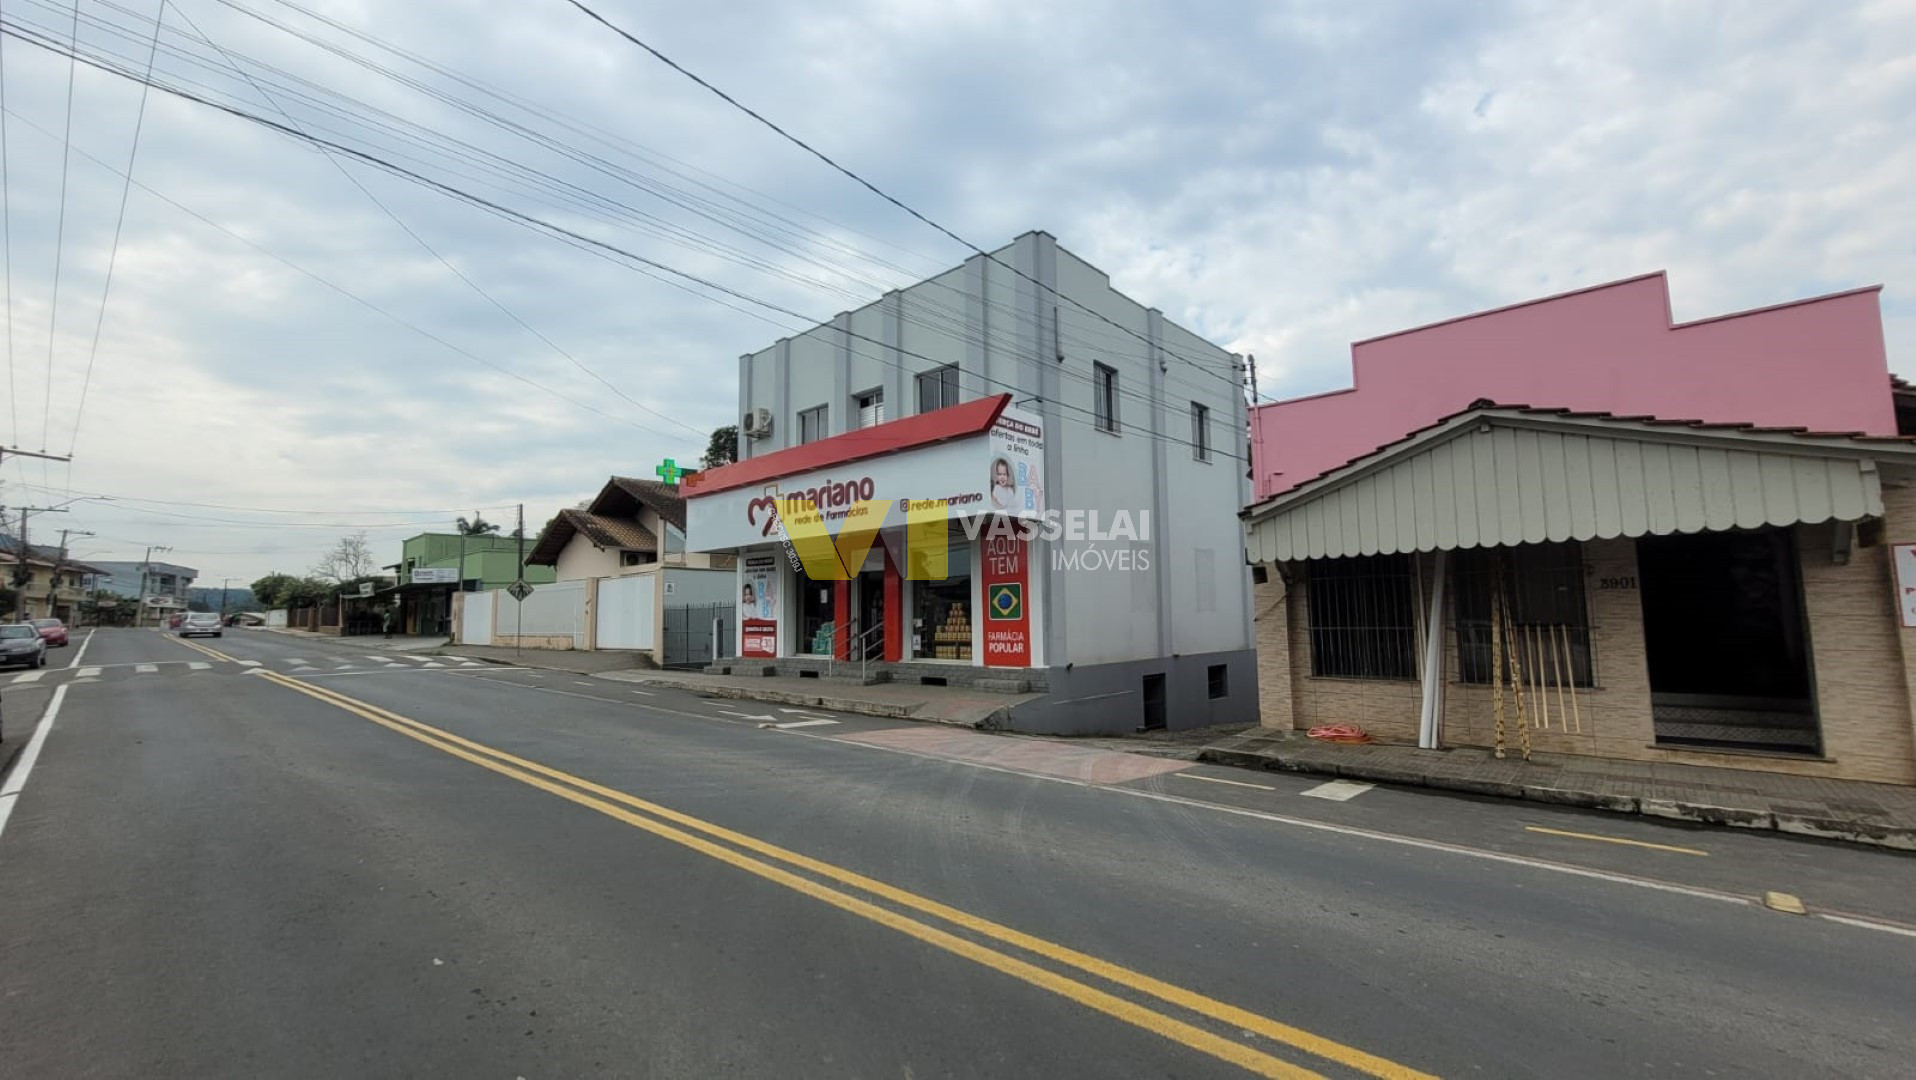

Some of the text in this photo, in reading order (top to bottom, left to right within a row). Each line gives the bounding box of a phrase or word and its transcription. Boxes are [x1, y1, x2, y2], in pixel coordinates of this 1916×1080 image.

[990, 429, 1015, 443] ofertas
[786, 477, 875, 515] mariano
[794, 513, 812, 525] rede
[813, 514, 824, 523] de
[987, 535, 1020, 556] AQUI
[989, 555, 1019, 576] TEM
[988, 629, 1024, 641] FARMÁCIA
[988, 641, 1025, 654] POPULAR
